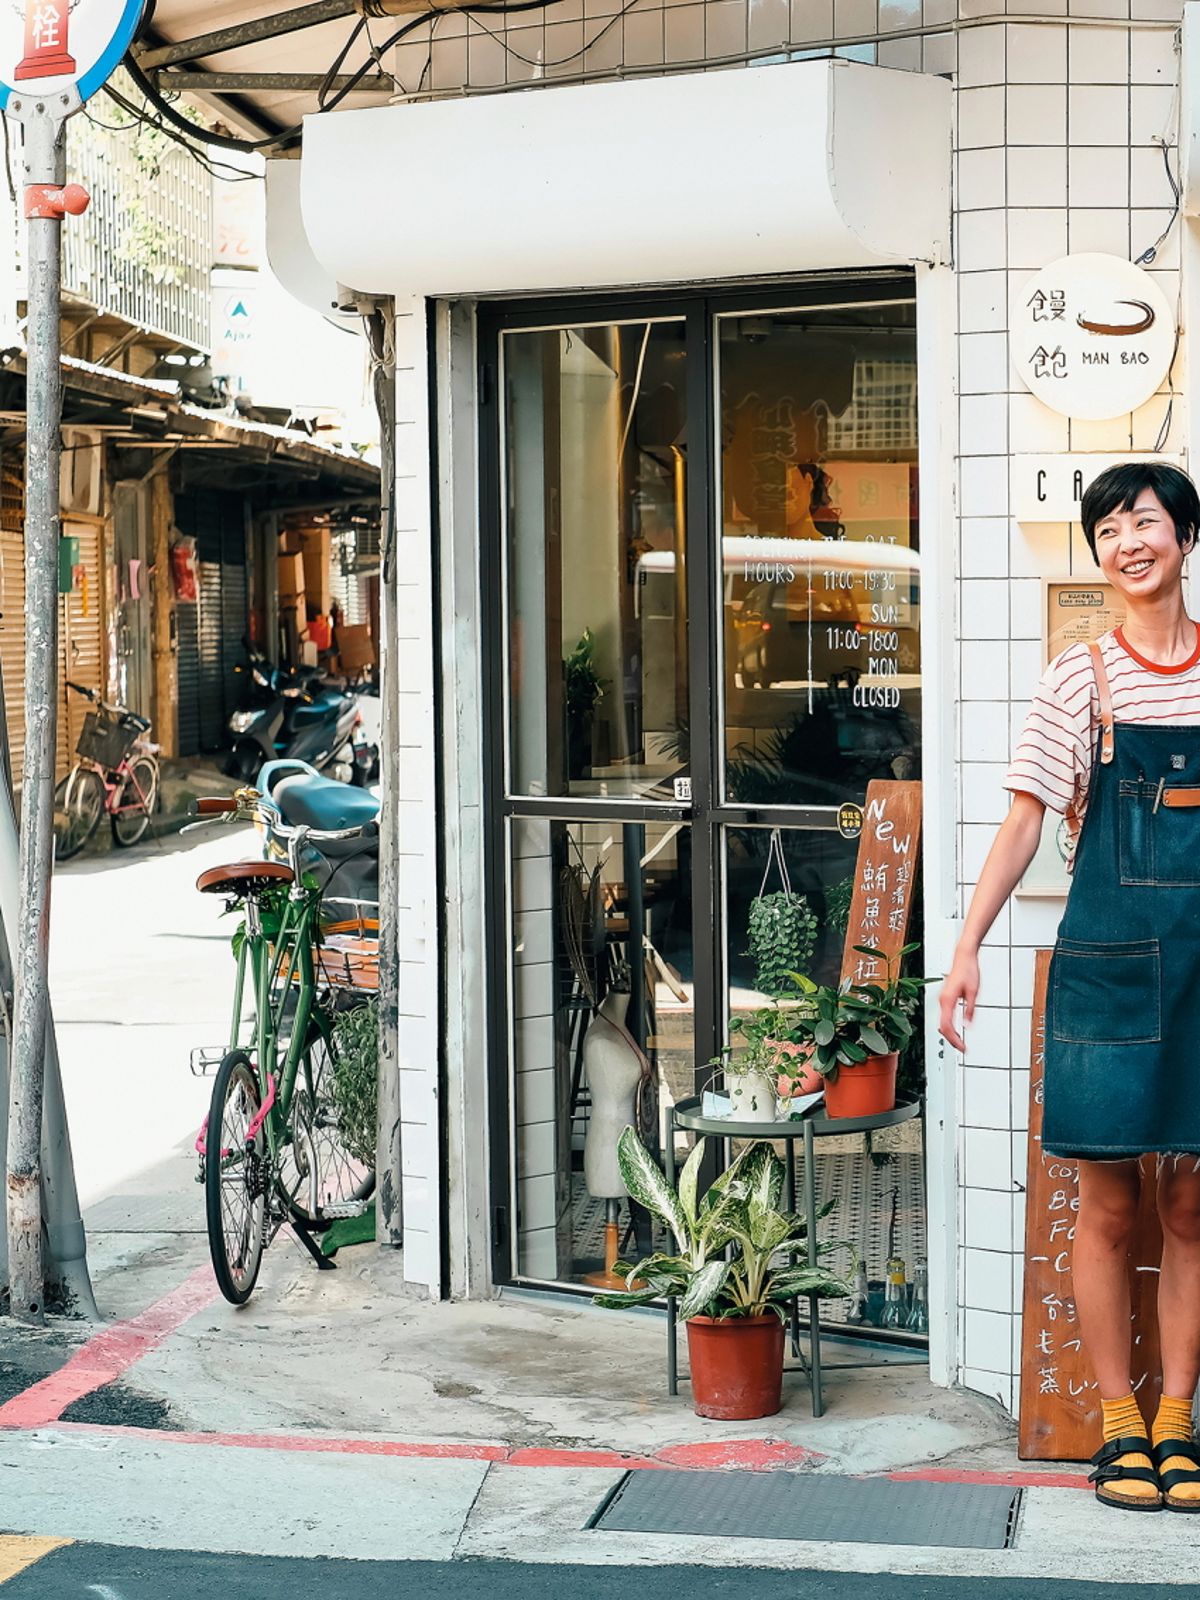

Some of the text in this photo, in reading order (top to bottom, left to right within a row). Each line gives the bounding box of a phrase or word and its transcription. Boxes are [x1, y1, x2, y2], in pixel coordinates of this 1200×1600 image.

[32, 0, 62, 49] 栓
[1082, 351, 1150, 365] MAN BAO
[1037, 469, 1083, 502] CA
[744, 561, 795, 584] HOURS
[870, 603, 898, 623] SUN
[869, 657, 898, 679] MON
[852, 685, 900, 708] CLOSED
[1048, 1190, 1080, 1211] Be
